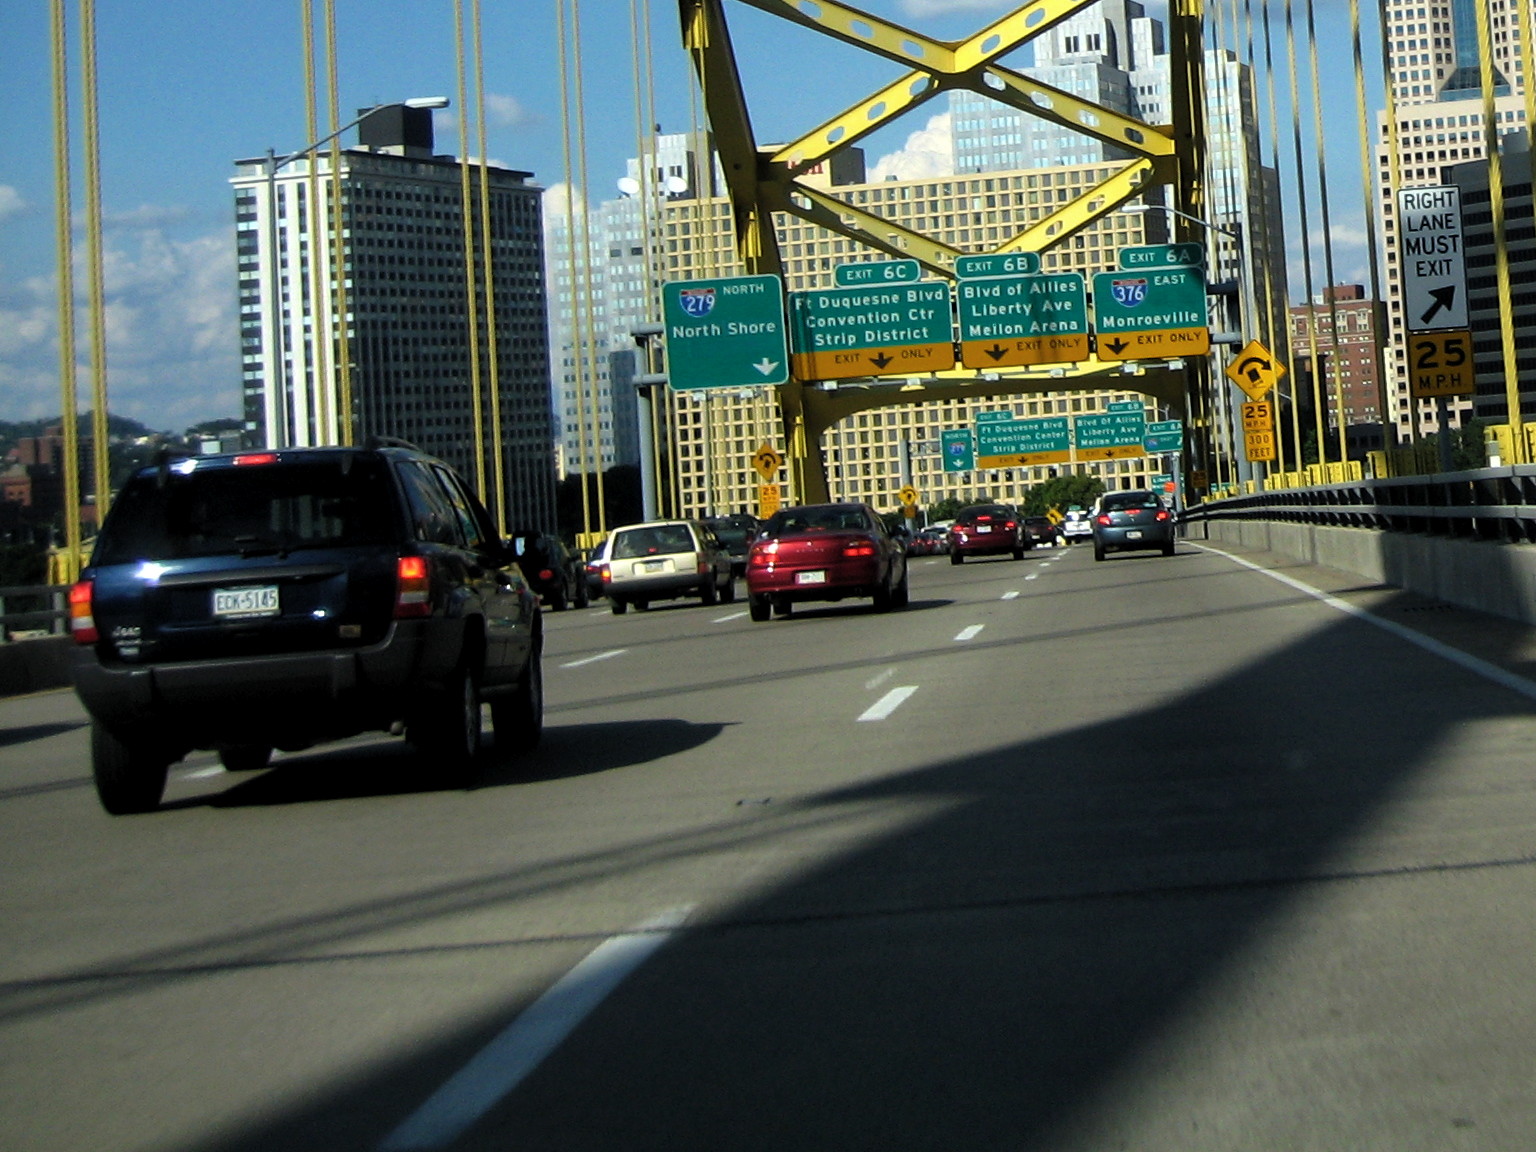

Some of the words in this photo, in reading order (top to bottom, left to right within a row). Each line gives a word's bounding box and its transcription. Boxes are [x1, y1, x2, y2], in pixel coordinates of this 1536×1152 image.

[1404, 191, 1455, 210] RIGHT
[1407, 213, 1455, 232] LANE
[1406, 234, 1459, 257] MUST
[1129, 252, 1155, 263] EXIT
[1166, 249, 1191, 263] 6A
[846, 269, 872, 280] EXIT
[883, 265, 906, 280] 6C
[966, 261, 992, 272] EXIT
[1003, 257, 1028, 271] 6B
[1416, 259, 1453, 277] EXIT
[1154, 274, 1186, 286] EAST
[723, 283, 765, 295] NORTH
[964, 285, 1000, 298] Blvd
[1007, 283, 1022, 295] of
[1029, 281, 1077, 294] Allies
[1116, 285, 1144, 302] 376
[686, 294, 716, 312] 279
[795, 297, 812, 310] Ft
[819, 292, 900, 309] Duquesne
[907, 289, 944, 303] Blvd
[971, 301, 1032, 316] Liberty
[1042, 300, 1072, 312] Ave
[806, 311, 900, 328] Convention
[908, 308, 935, 321] Ctr
[1103, 311, 1199, 328] Monroeville
[672, 324, 721, 339] North
[727, 322, 776, 336] Shore
[814, 332, 857, 347] Strip
[865, 326, 929, 342] District
[969, 323, 1023, 337] Mellon
[1029, 320, 1078, 333] Arena
[1016, 340, 1042, 351] EXIT
[1049, 338, 1081, 349] ONLY
[1137, 334, 1163, 345] EXIT
[1170, 331, 1202, 343] ONLY
[834, 353, 860, 364] EXIT
[901, 348, 933, 359] ONLY
[1415, 338, 1466, 369] 25
[1246, 405, 1268, 418] 25
[995, 423, 1039, 433] Duquesne
[1083, 427, 1115, 436] Liberty
[980, 434, 1032, 444] Convention
[1035, 431, 1065, 440] Center
[1248, 434, 1270, 445] 300
[1019, 441, 1055, 451] District
[1248, 447, 1271, 458] FEET
